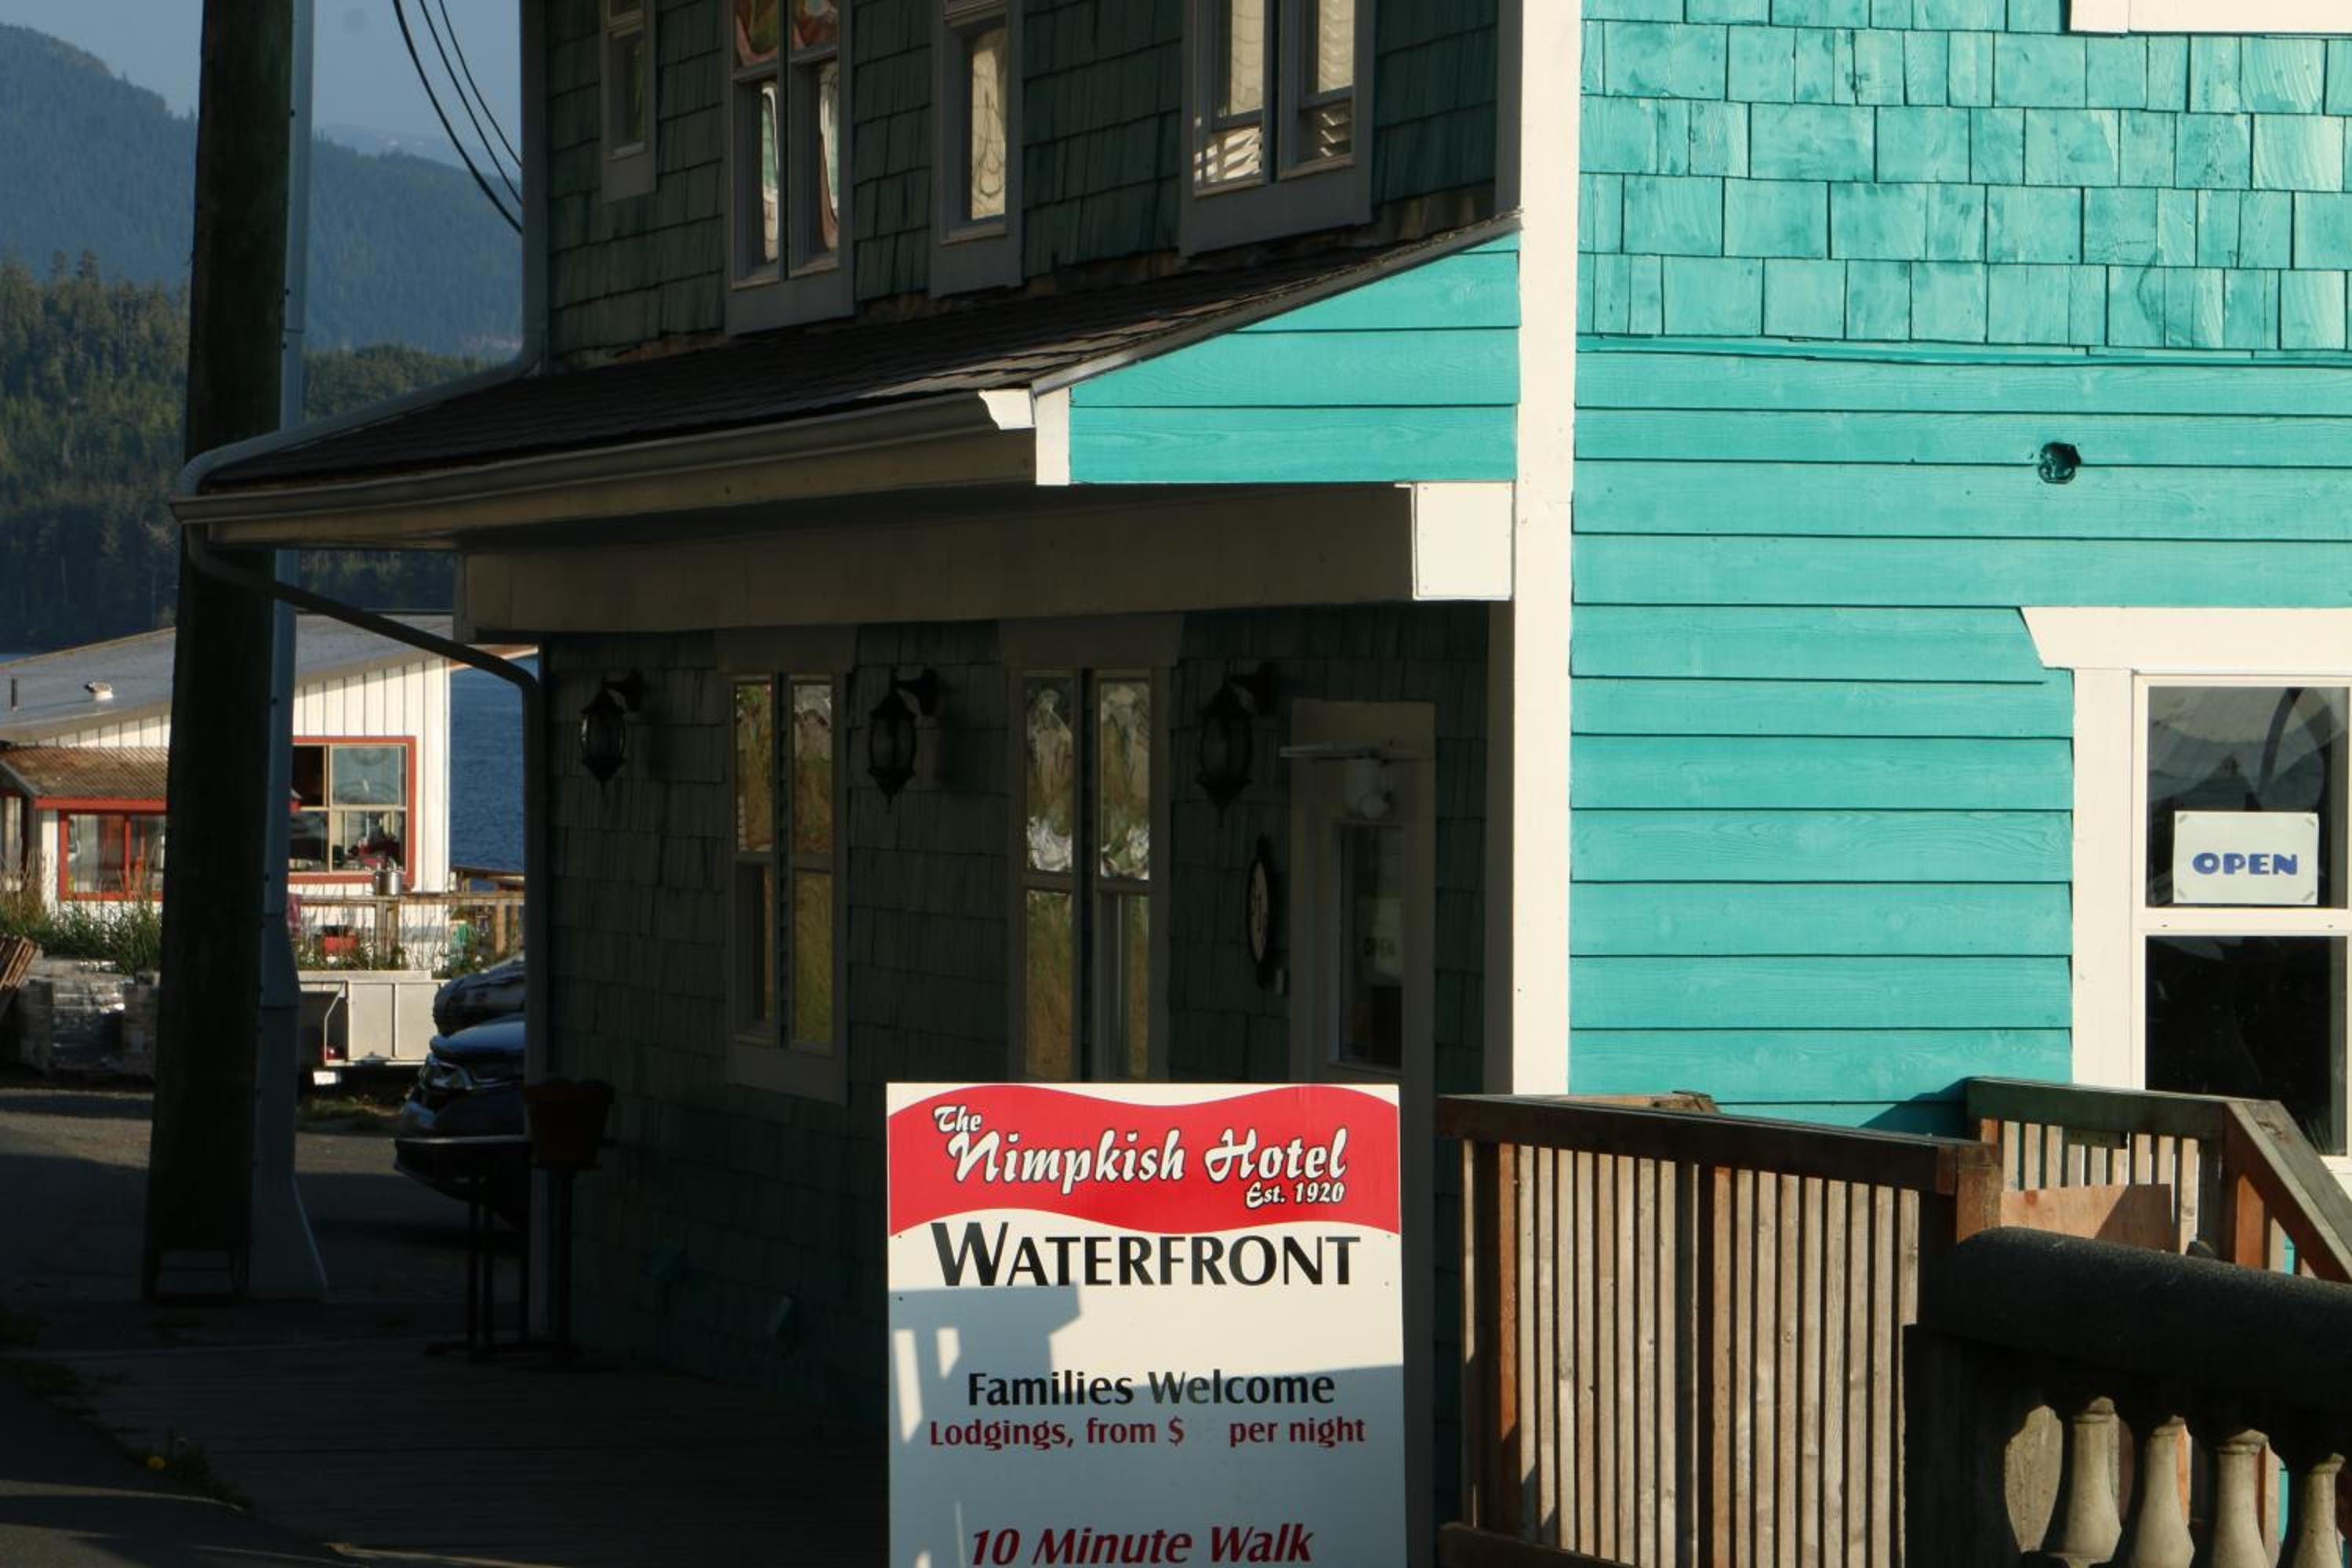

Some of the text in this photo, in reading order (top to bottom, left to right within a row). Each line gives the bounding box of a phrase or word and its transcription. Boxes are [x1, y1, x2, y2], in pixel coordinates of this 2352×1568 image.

[2192, 852, 2298, 875] OPEN
[933, 1104, 982, 1132] The
[946, 1127, 1348, 1195] Nimpkish Hotel
[1245, 1180, 1345, 1209] Est. 1920
[931, 1222, 1360, 1286] WATERFRONT
[968, 1369, 1336, 1406] Families Welcome
[930, 1415, 1367, 1451] Lodgings, from $ per night
[971, 1523, 1315, 1566] 10 Minute Walk
